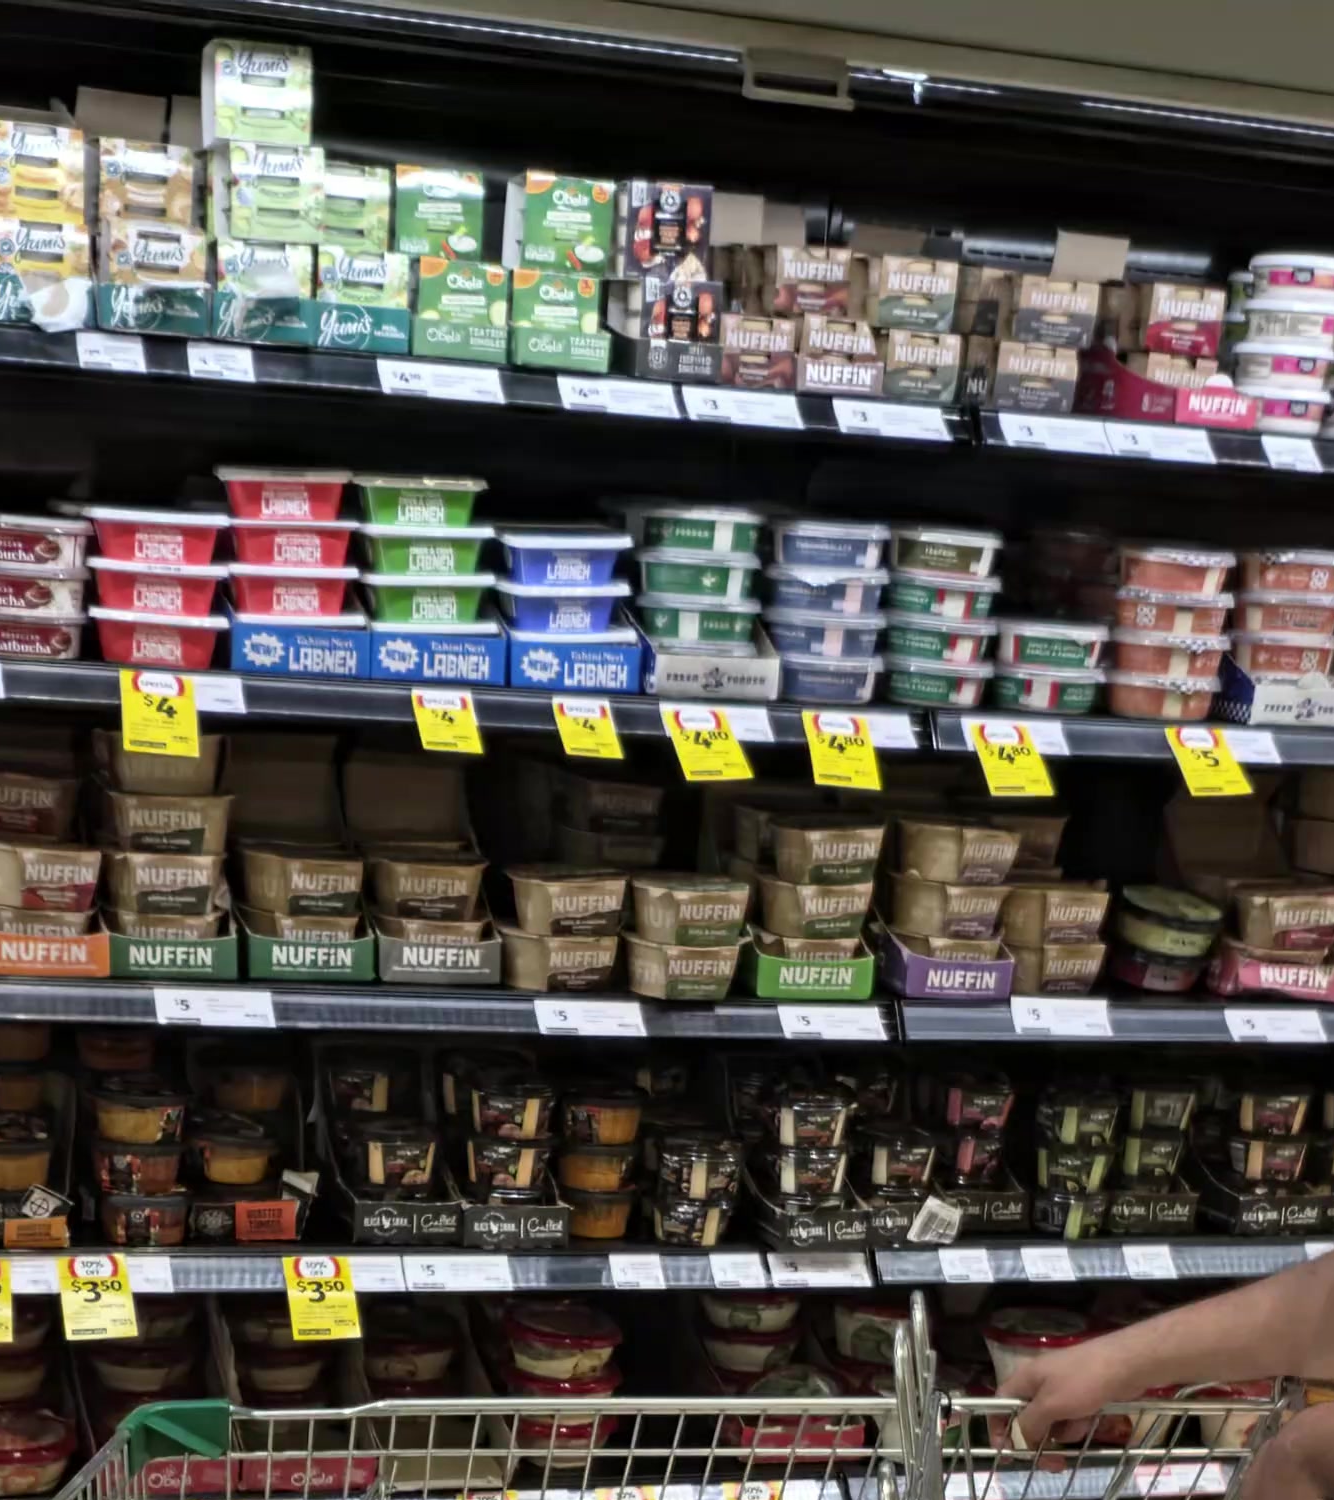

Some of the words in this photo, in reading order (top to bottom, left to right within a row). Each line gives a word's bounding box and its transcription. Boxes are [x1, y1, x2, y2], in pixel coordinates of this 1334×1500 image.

[288, 646, 357, 675] LABNEH
[423, 651, 490, 680] LABNEH
[563, 662, 628, 689] LABNEH
